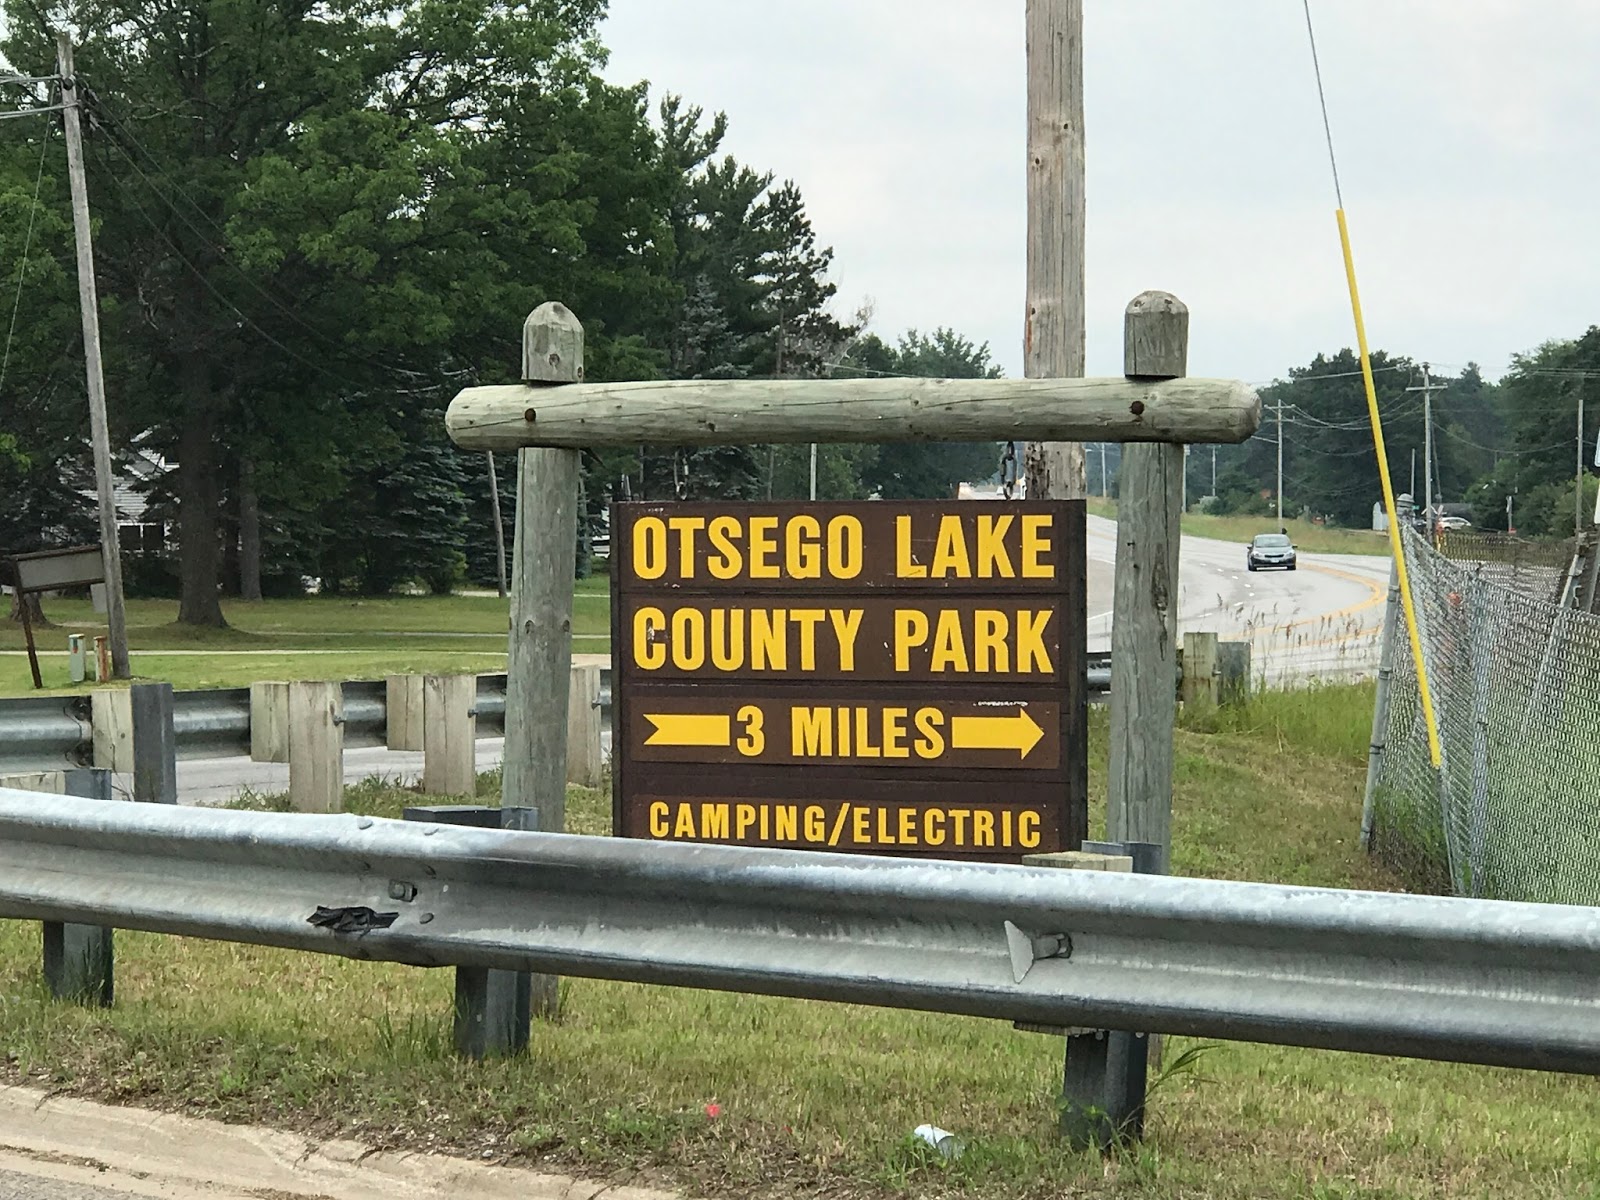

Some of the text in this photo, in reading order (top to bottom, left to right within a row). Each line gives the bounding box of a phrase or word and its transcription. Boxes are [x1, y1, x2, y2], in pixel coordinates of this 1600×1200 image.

[632, 514, 1055, 580] OTSEGO LAKE
[633, 606, 1054, 673] COUNTY PARK
[736, 705, 945, 759] 3 MILES
[649, 801, 1041, 848] CAMPING/ELECTRIC
